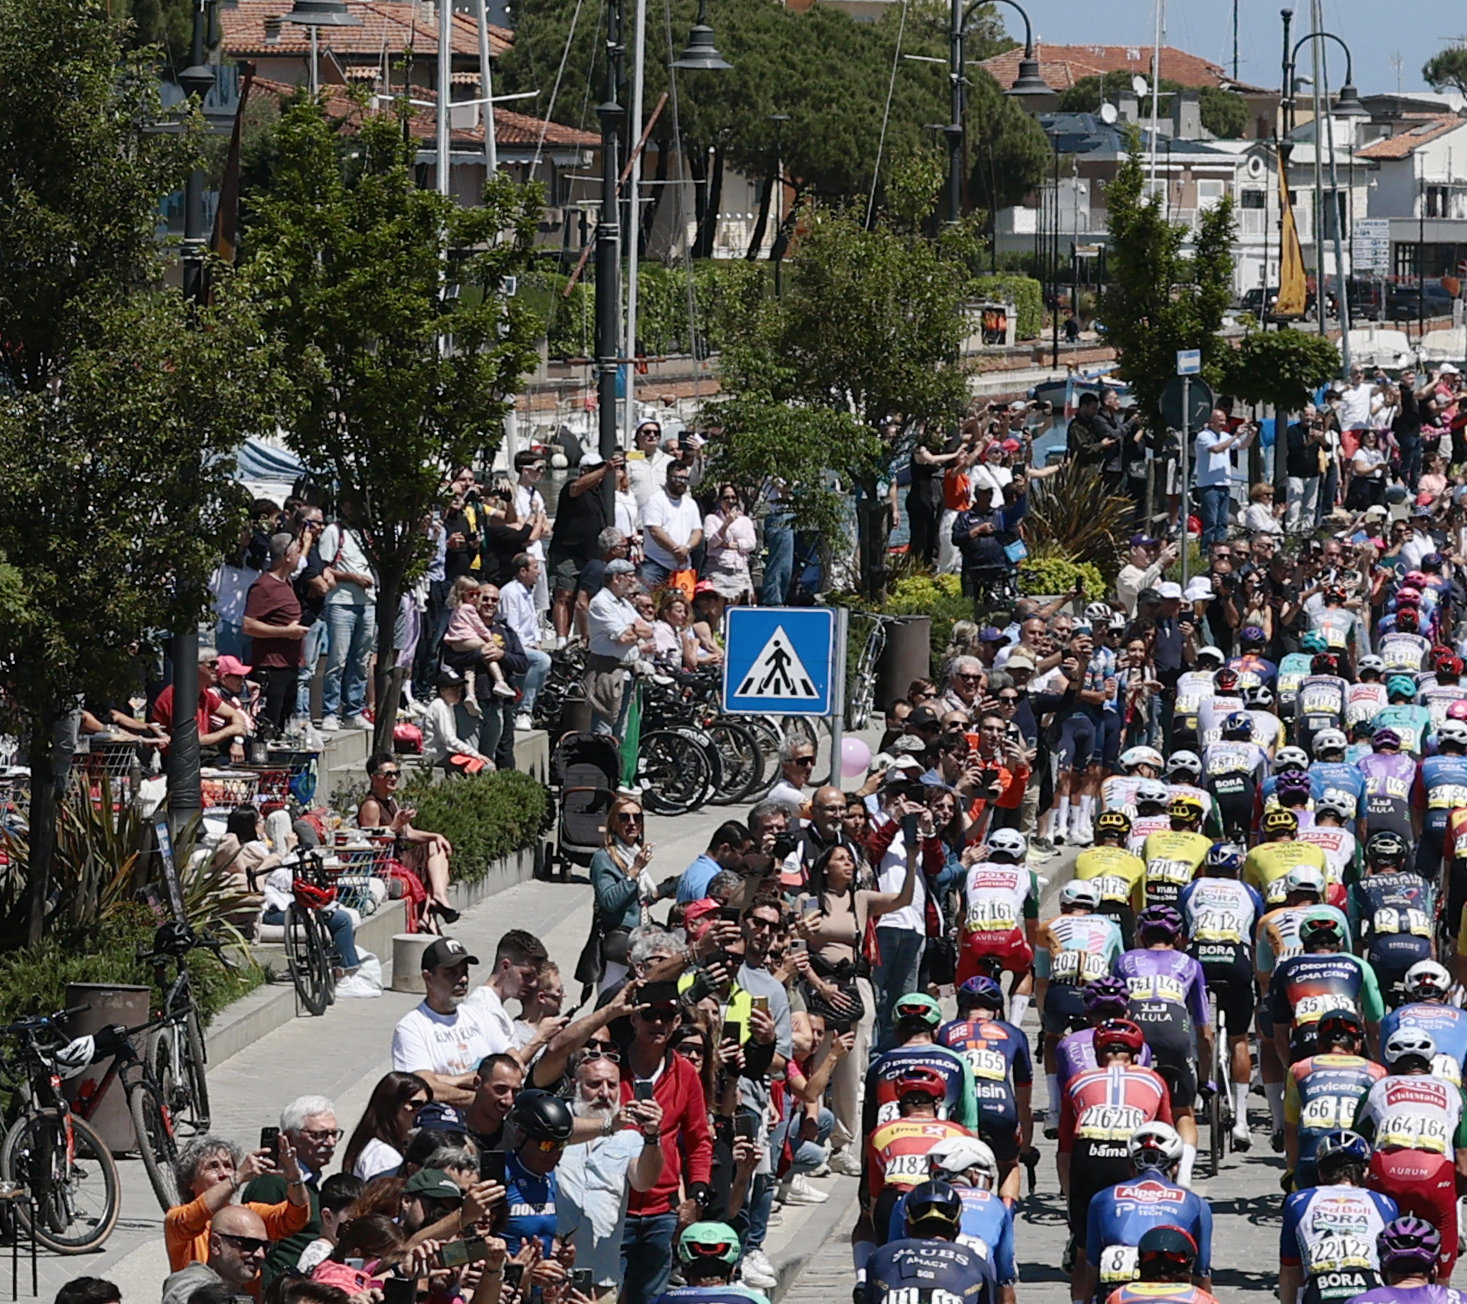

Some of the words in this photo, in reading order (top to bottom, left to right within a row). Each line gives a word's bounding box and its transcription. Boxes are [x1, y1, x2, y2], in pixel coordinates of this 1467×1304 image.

[977, 871, 1018, 881] POLTI
[990, 904, 1011, 921] 167
[1378, 909, 1393, 925] 12
[1198, 945, 1236, 956] BORA
[1300, 962, 1359, 974] DECATHLON
[1295, 973, 1322, 983] CMA
[1322, 971, 1349, 980] CGM
[1299, 1000, 1318, 1014] 35
[1133, 1013, 1173, 1022] ALULA
[892, 1058, 960, 1073] DECATHLON
[1387, 1080, 1445, 1094] POLTI
[1389, 1091, 1445, 1106] VisitMalta
[1309, 1100, 1329, 1118] 66
[1081, 1107, 1111, 1129] 216
[1113, 1109, 1143, 1129] 216
[1381, 1116, 1413, 1133] 164
[1420, 1117, 1446, 1141] 164
[1389, 1166, 1429, 1176] AURUM
[1121, 1188, 1178, 1199] Alpecin
[1138, 1205, 1179, 1215] PREMIER
[1313, 1211, 1369, 1226] BORA
[906, 1257, 949, 1270] AMACX
[919, 1248, 970, 1267] UBS
[1113, 1250, 1125, 1271] 8
[917, 1269, 936, 1280] SGS
[1316, 1274, 1366, 1290] BORA
